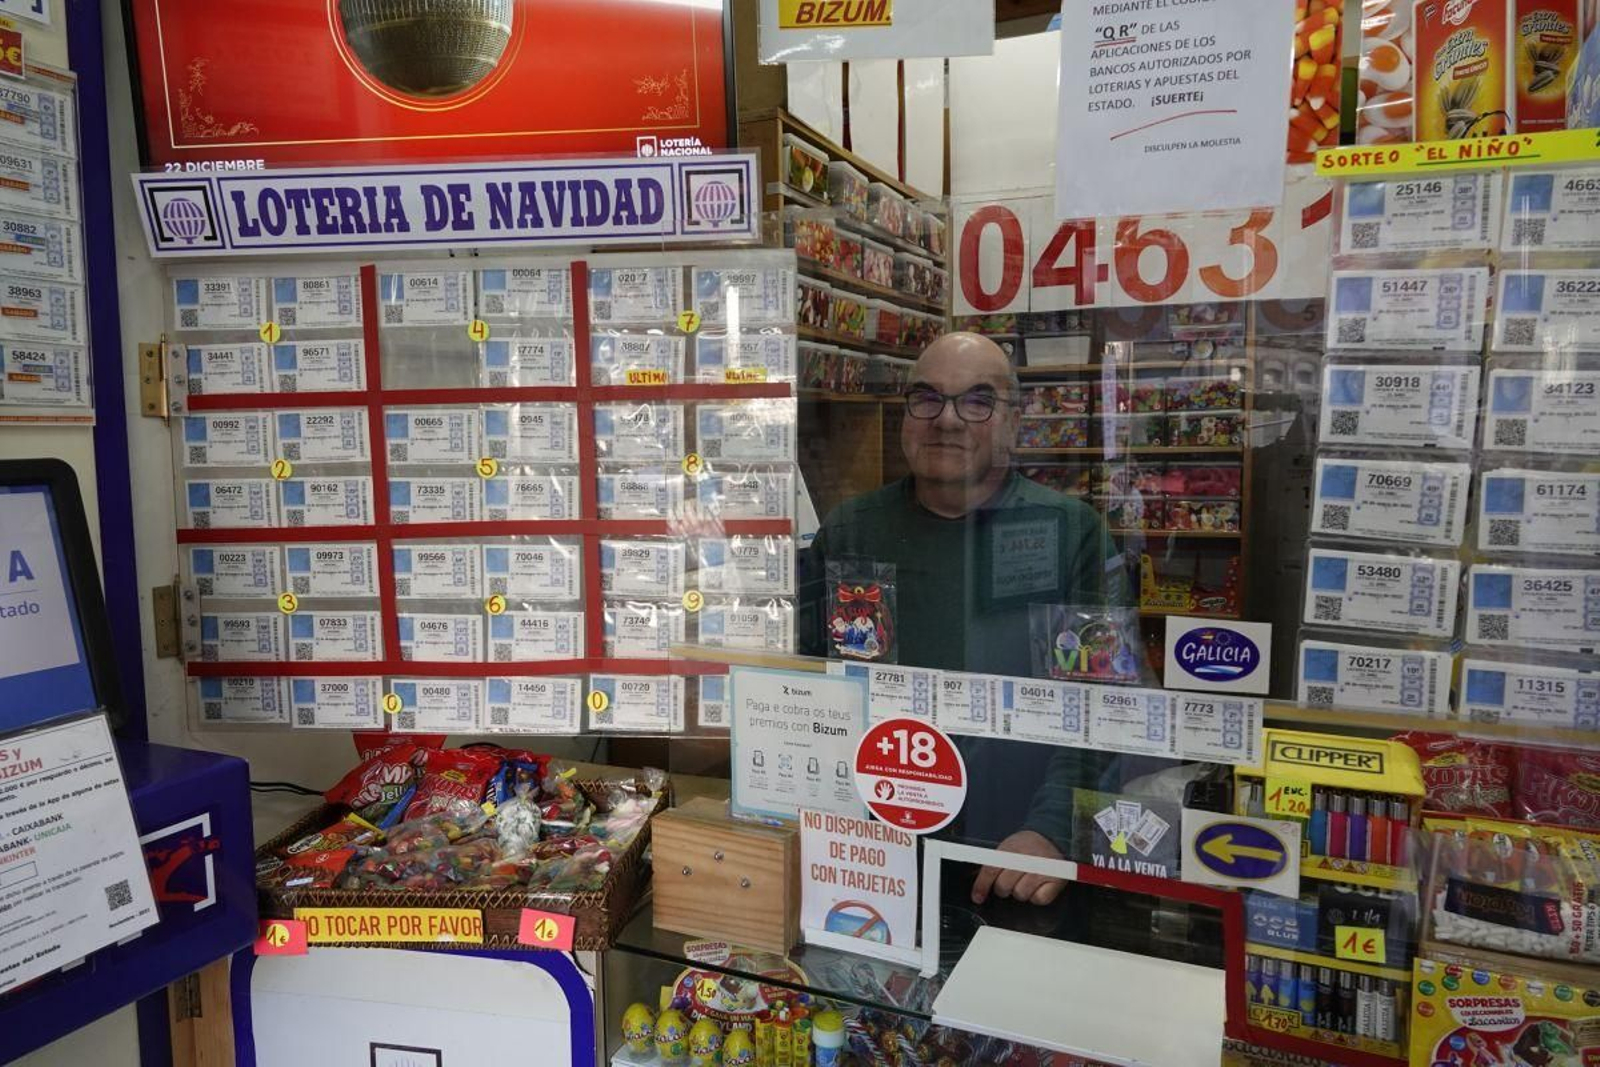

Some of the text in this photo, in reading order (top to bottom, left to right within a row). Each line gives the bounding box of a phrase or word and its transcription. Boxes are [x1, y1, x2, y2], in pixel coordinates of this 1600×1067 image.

[1093, 1, 1153, 16] MEDIANTE
[1156, 0, 1168, 9] EL
[1142, 24, 1156, 35] DE
[1159, 21, 1180, 33] LAS
[1091, 36, 1216, 60] APLICACIONES DE LOS
[1090, 50, 1251, 77] BANCOS AUTORIZADOS POR
[1089, 70, 1239, 94] LOTERIAS Y APUESTAS DEL
[1088, 98, 1135, 112] ESTADO.
[660, 137, 702, 147] LOTERÍA
[1144, 137, 1241, 153] DISCULPEN LA MOLESTIA
[660, 146, 712, 156] NACIONAL
[165, 159, 266, 172] 22 DICIEMBRE
[1322, 150, 1400, 168] SORTEO
[1396, 182, 1442, 197] 25146
[231, 176, 666, 238] LOTERIA DE NAVIDAD
[3, 220, 37, 235] 30882
[410, 277, 438, 287] 00614
[1382, 281, 1428, 293] 51447
[8, 285, 42, 299] 38963
[683, 315, 695, 331] 7
[264, 324, 274, 342] 1
[473, 324, 484, 338] 4
[12, 350, 46, 362] 58424
[1375, 376, 1421, 388] 30918
[1544, 382, 1595, 395] 34123
[212, 420, 239, 429] 00992
[306, 416, 334, 425] 22292
[414, 417, 443, 426] 00665
[275, 460, 286, 479] 2
[479, 459, 494, 476] 5
[686, 455, 698, 472] 8
[1367, 474, 1412, 488] 70669
[215, 486, 242, 495] 06472
[310, 484, 338, 493] 90162
[417, 485, 445, 495] 73335
[1537, 484, 1587, 497] 61174
[219, 553, 246, 562] 00223
[316, 551, 343, 560] 09973
[515, 552, 544, 562] 70046
[1357, 565, 1401, 579] 53480
[1524, 580, 1573, 593] 36425
[282, 594, 295, 612] 3
[489, 595, 501, 612] 6
[687, 592, 699, 610] 9
[319, 618, 347, 627] 07833
[420, 621, 448, 630] 04676
[520, 619, 549, 628] 44416
[1182, 642, 1251, 663] GALICIA
[1349, 655, 1391, 669] 70217
[876, 672, 905, 683] 27781
[321, 683, 348, 692] 37000
[1021, 687, 1054, 698] 04014
[1517, 679, 1565, 693] 11315
[1102, 695, 1137, 706] 52961
[746, 698, 851, 720] Paga e cobra os teus
[750, 717, 847, 736] premios con Bizum
[877, 729, 937, 768] +18
[11, 813, 64, 836] CAIXABANK
[804, 811, 912, 848] NO DISPONEMOS
[34, 823, 72, 841] UNICAJA
[830, 841, 886, 868] DE PAGO
[1091, 854, 1167, 878] YA A LA VENTA
[811, 863, 906, 898] CON TARJETAS
[324, 914, 381, 937] TOCAR
[388, 914, 422, 937] POR
[428, 915, 483, 937] FAVOR
[1448, 997, 1521, 1009] SORPRESAS
